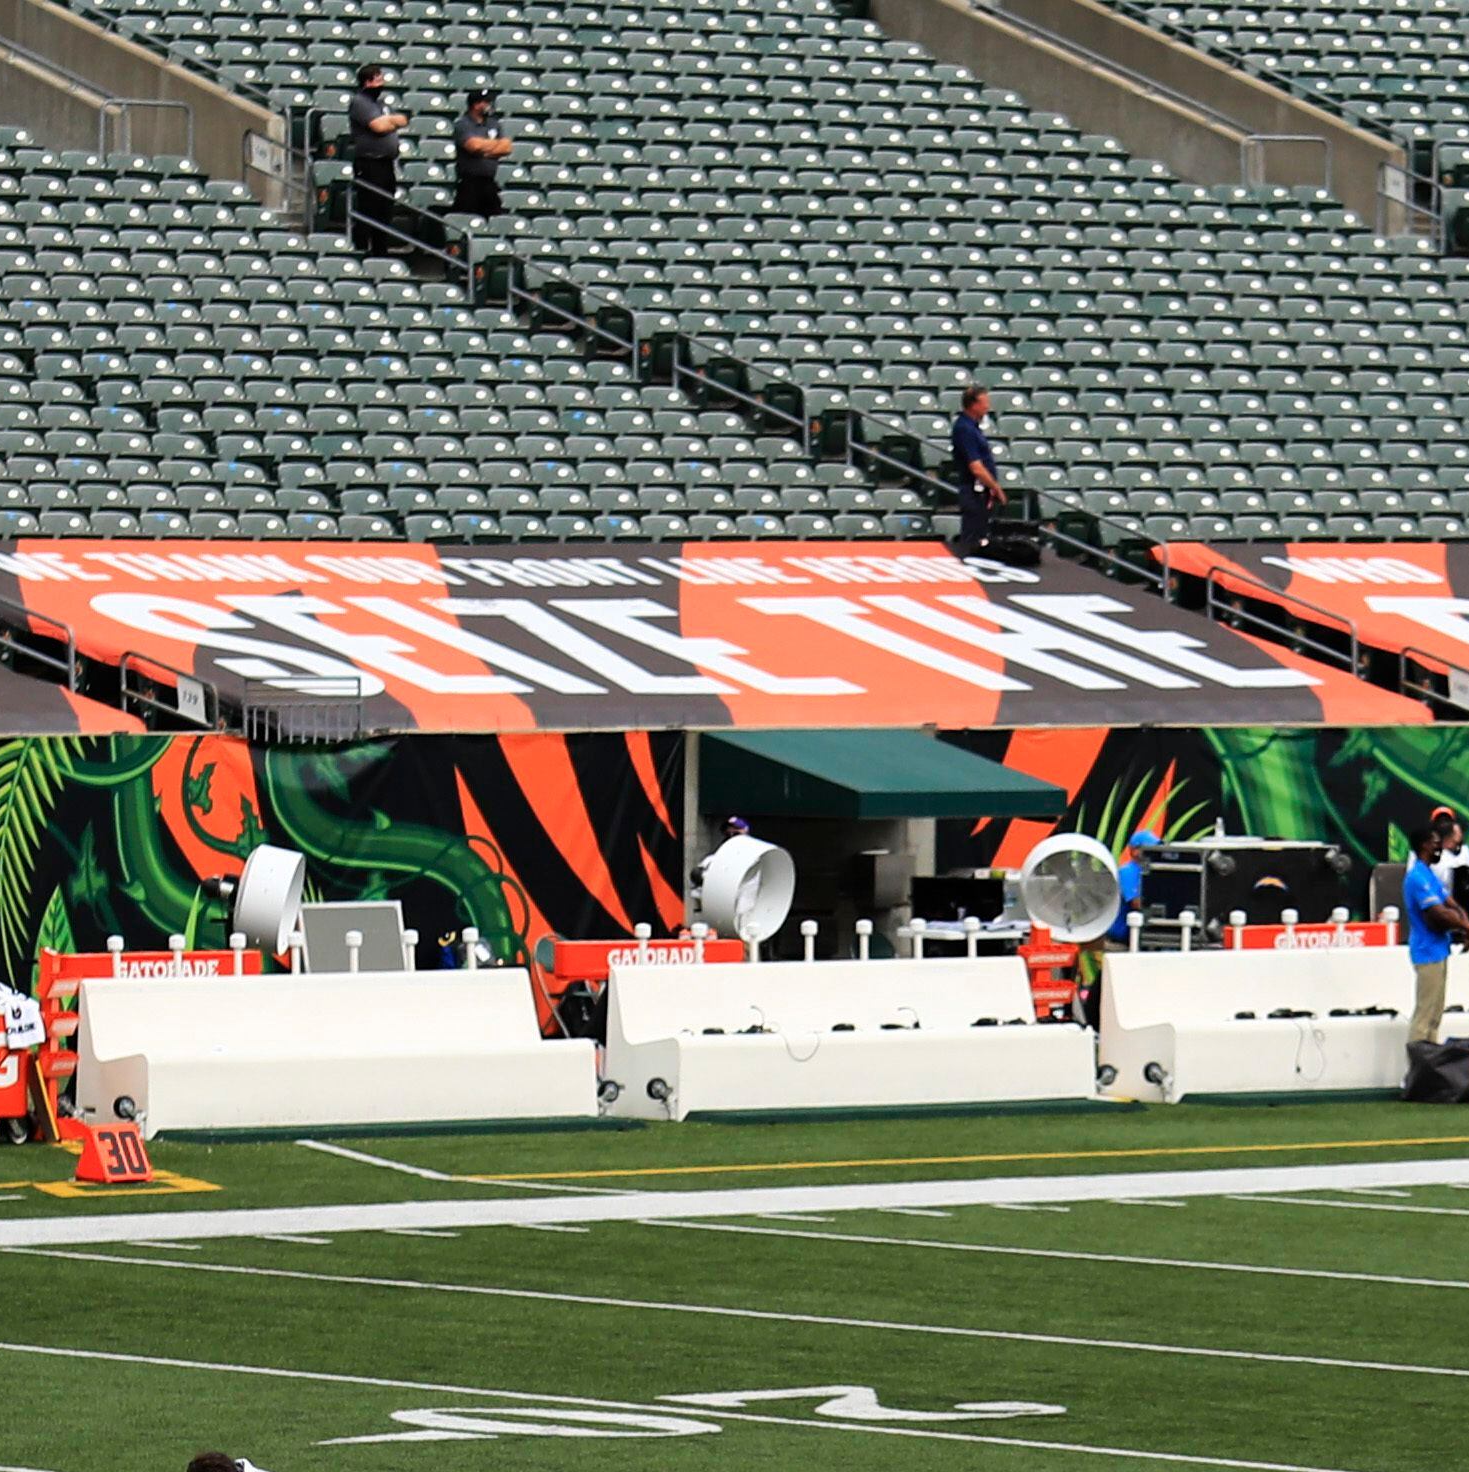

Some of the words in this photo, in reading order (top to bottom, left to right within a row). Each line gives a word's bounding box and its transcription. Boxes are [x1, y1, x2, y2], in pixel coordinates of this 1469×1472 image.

[83, 553, 330, 583] THANK
[304, 555, 467, 585] OUR
[437, 557, 662, 587] FRONT
[637, 557, 813, 585] LINE
[781, 556, 1041, 583] HEROES
[1261, 556, 1444, 584] WHO
[89, 592, 867, 697] SEIZE
[735, 594, 1323, 691] THE
[99, 1130, 146, 1176] 30
